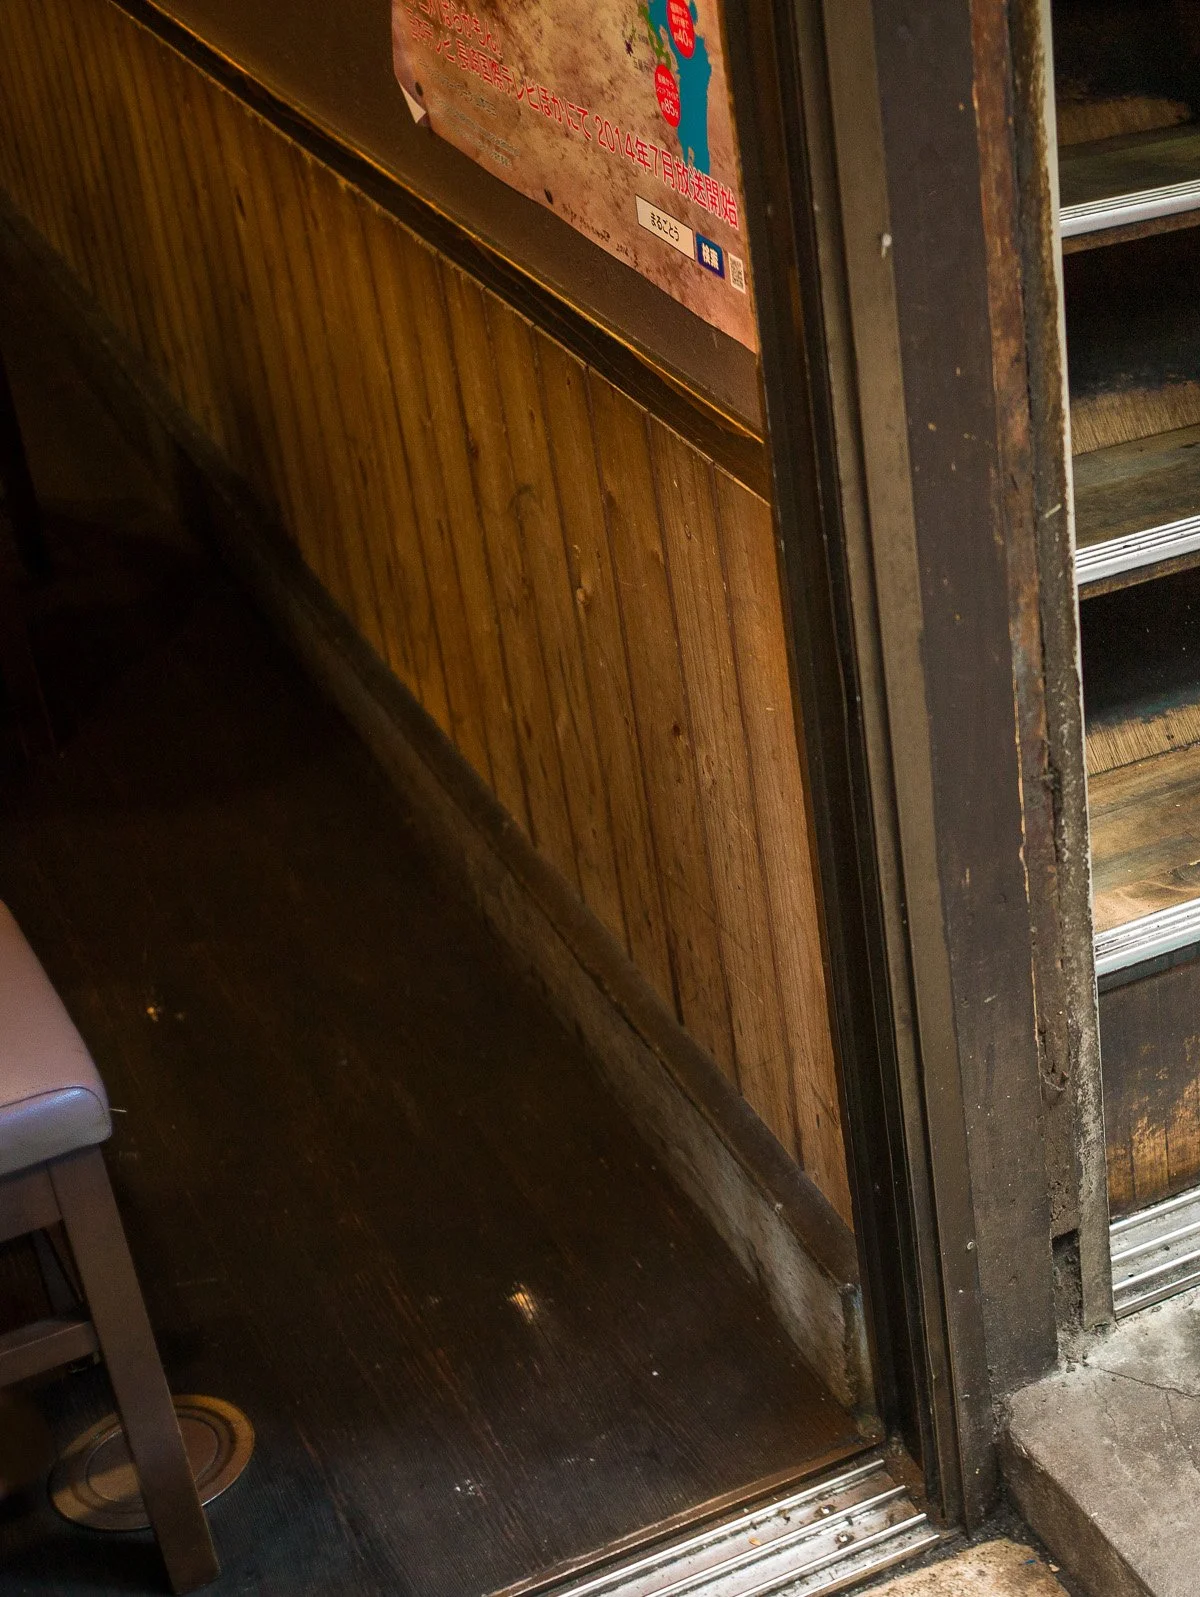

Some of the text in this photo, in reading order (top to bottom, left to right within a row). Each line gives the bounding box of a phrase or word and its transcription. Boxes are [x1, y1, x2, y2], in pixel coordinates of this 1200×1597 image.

[594, 115, 740, 231] 2014年7月放送開始
[650, 211, 680, 242] まるごとう
